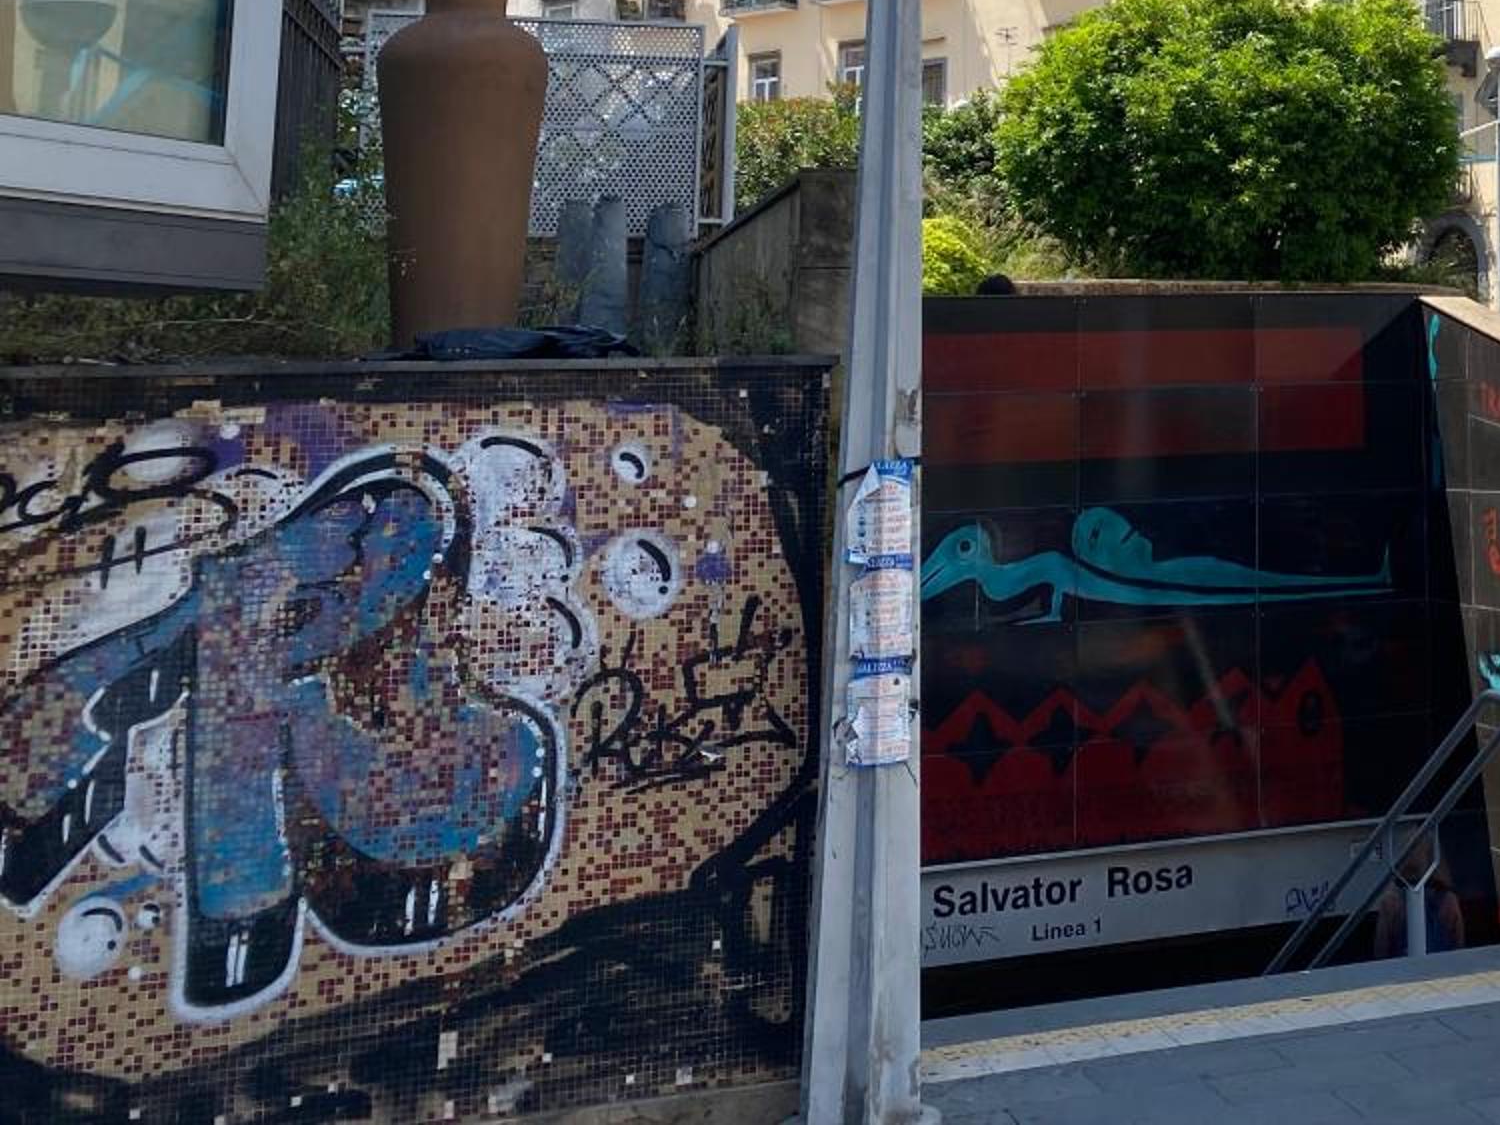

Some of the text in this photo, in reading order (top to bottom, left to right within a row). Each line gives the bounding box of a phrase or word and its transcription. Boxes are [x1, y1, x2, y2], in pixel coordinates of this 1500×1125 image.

[933, 864, 1194, 918] Salvator Rosa
[1031, 918, 1102, 942] Linea 1
